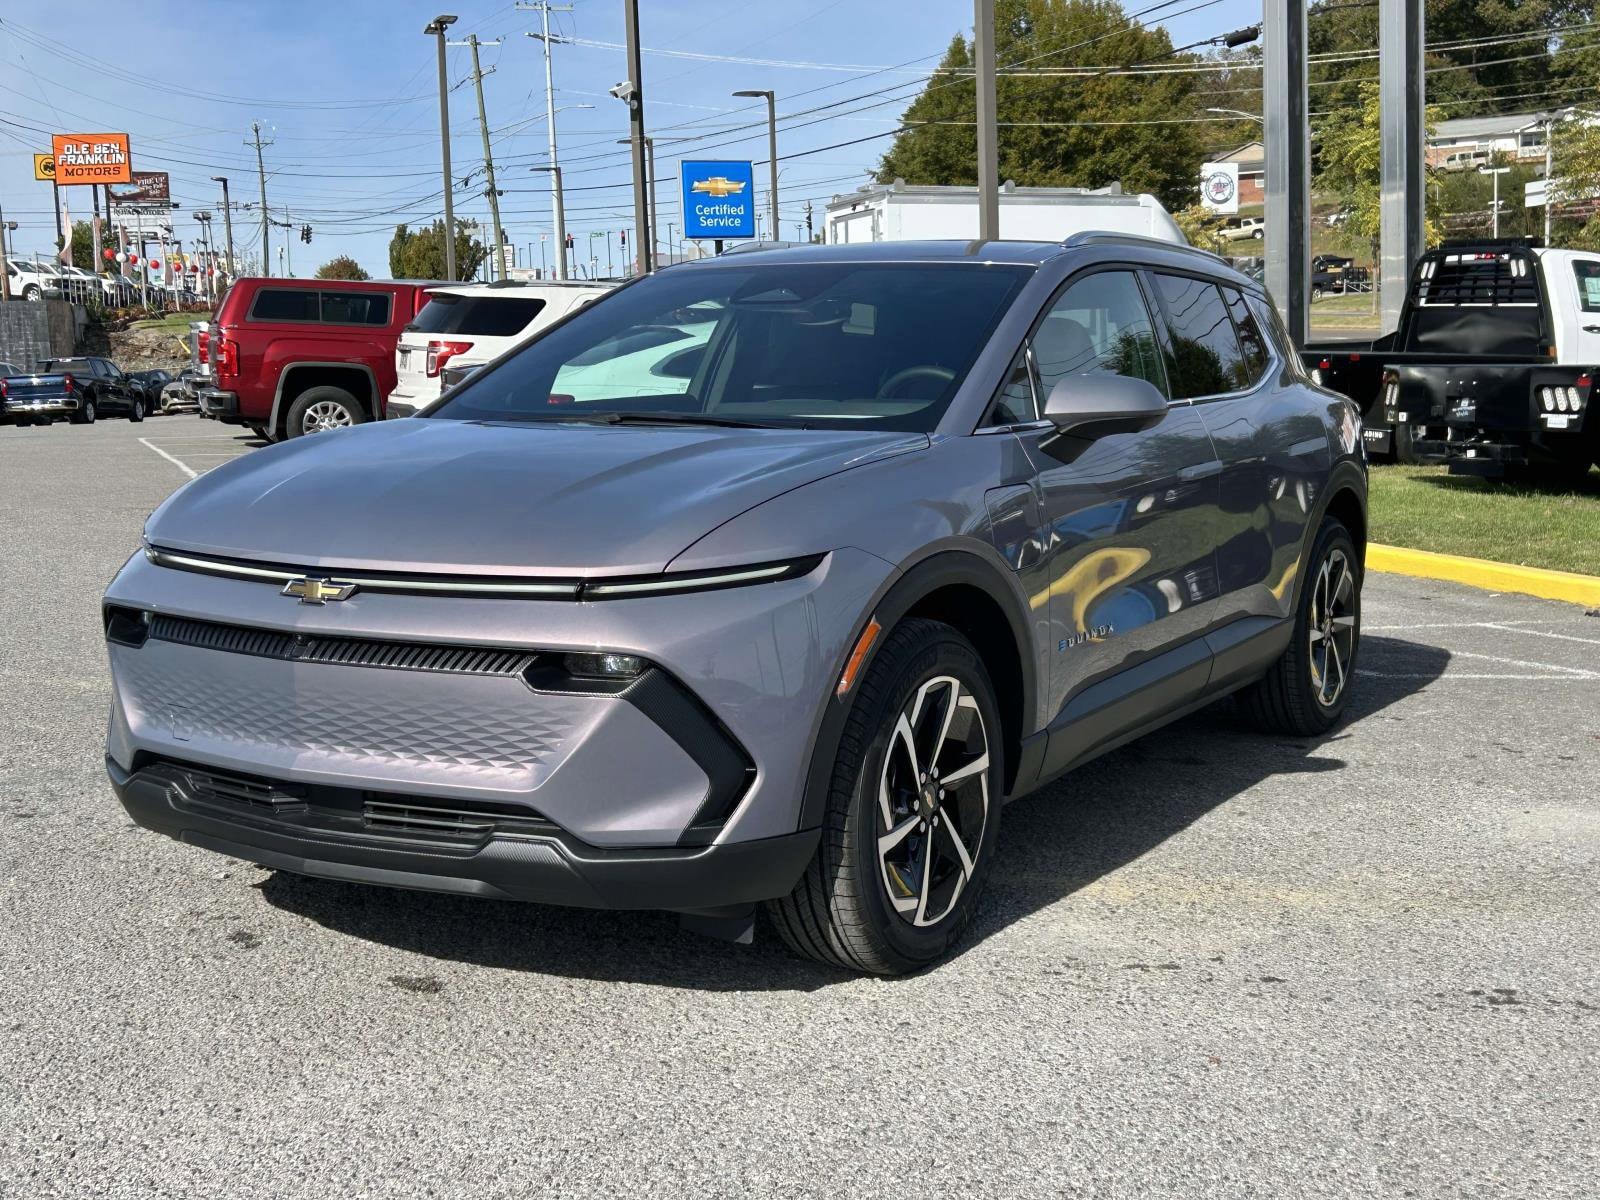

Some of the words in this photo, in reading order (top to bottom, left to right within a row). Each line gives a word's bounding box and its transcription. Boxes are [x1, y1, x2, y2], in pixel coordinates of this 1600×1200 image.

[64, 144, 90, 154] OLE
[93, 143, 120, 154] BEN
[58, 153, 125, 165] FRANKLIN
[65, 167, 120, 176] MOTORS
[695, 204, 744, 215] Certified
[700, 216, 741, 227] Service
[1057, 622, 1114, 653] EQUINOX
